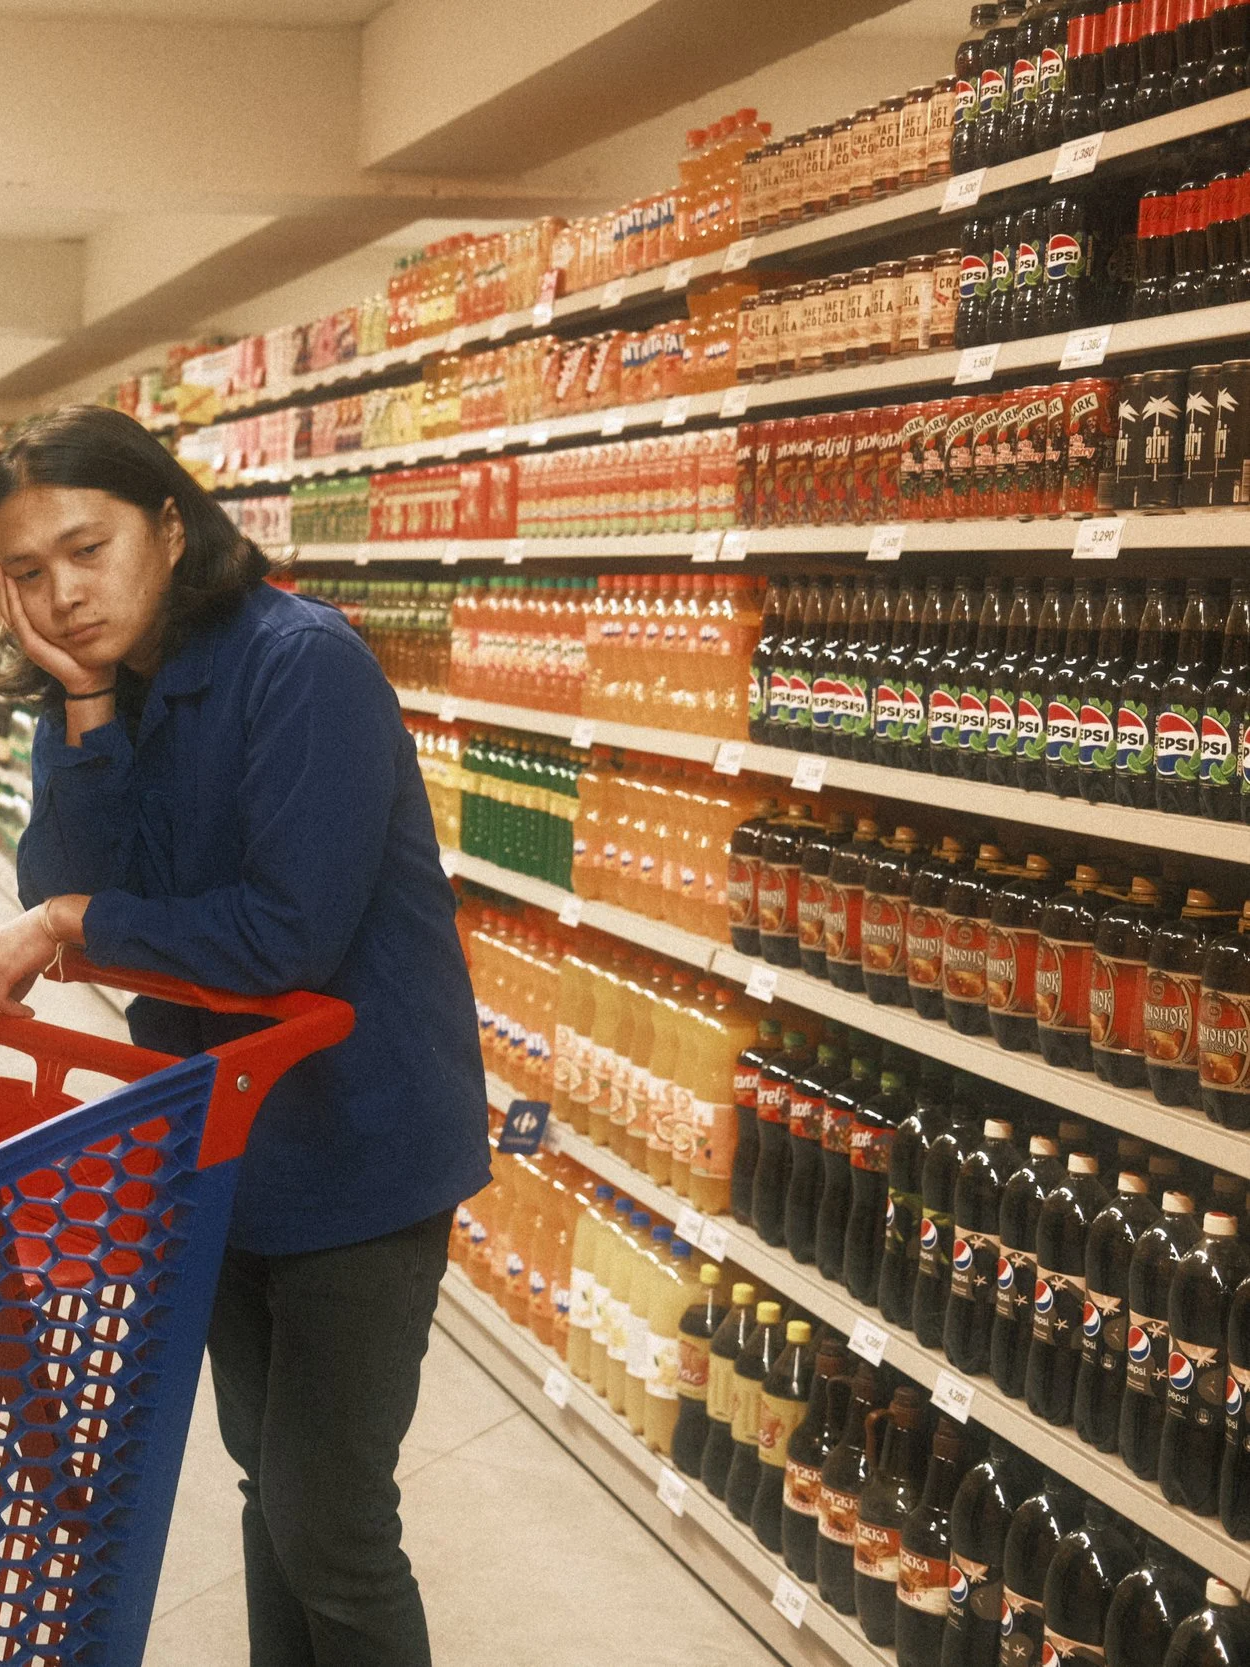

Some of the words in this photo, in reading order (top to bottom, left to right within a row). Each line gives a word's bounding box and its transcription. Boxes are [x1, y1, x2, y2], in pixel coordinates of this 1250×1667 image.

[876, 124, 900, 136] RAFT
[853, 133, 874, 145] CRAF
[878, 134, 901, 148] COL
[1050, 251, 1079, 262] EPSI
[1020, 260, 1035, 269] PSI
[961, 271, 986, 281] EPSI
[939, 277, 960, 289] CRA
[1018, 403, 1043, 427] BARK
[1145, 426, 1169, 459] afri
[1069, 447, 1095, 459] herry
[932, 711, 957, 723] EPSI
[1019, 721, 1039, 733] PSI
[1047, 725, 1077, 738] EPSI
[1080, 728, 1110, 743] EPSI
[1116, 732, 1144, 746] EPSI
[1159, 737, 1195, 751] EPSI
[1202, 740, 1227, 755] PSI
[1145, 1002, 1188, 1029] ЧОНОК
